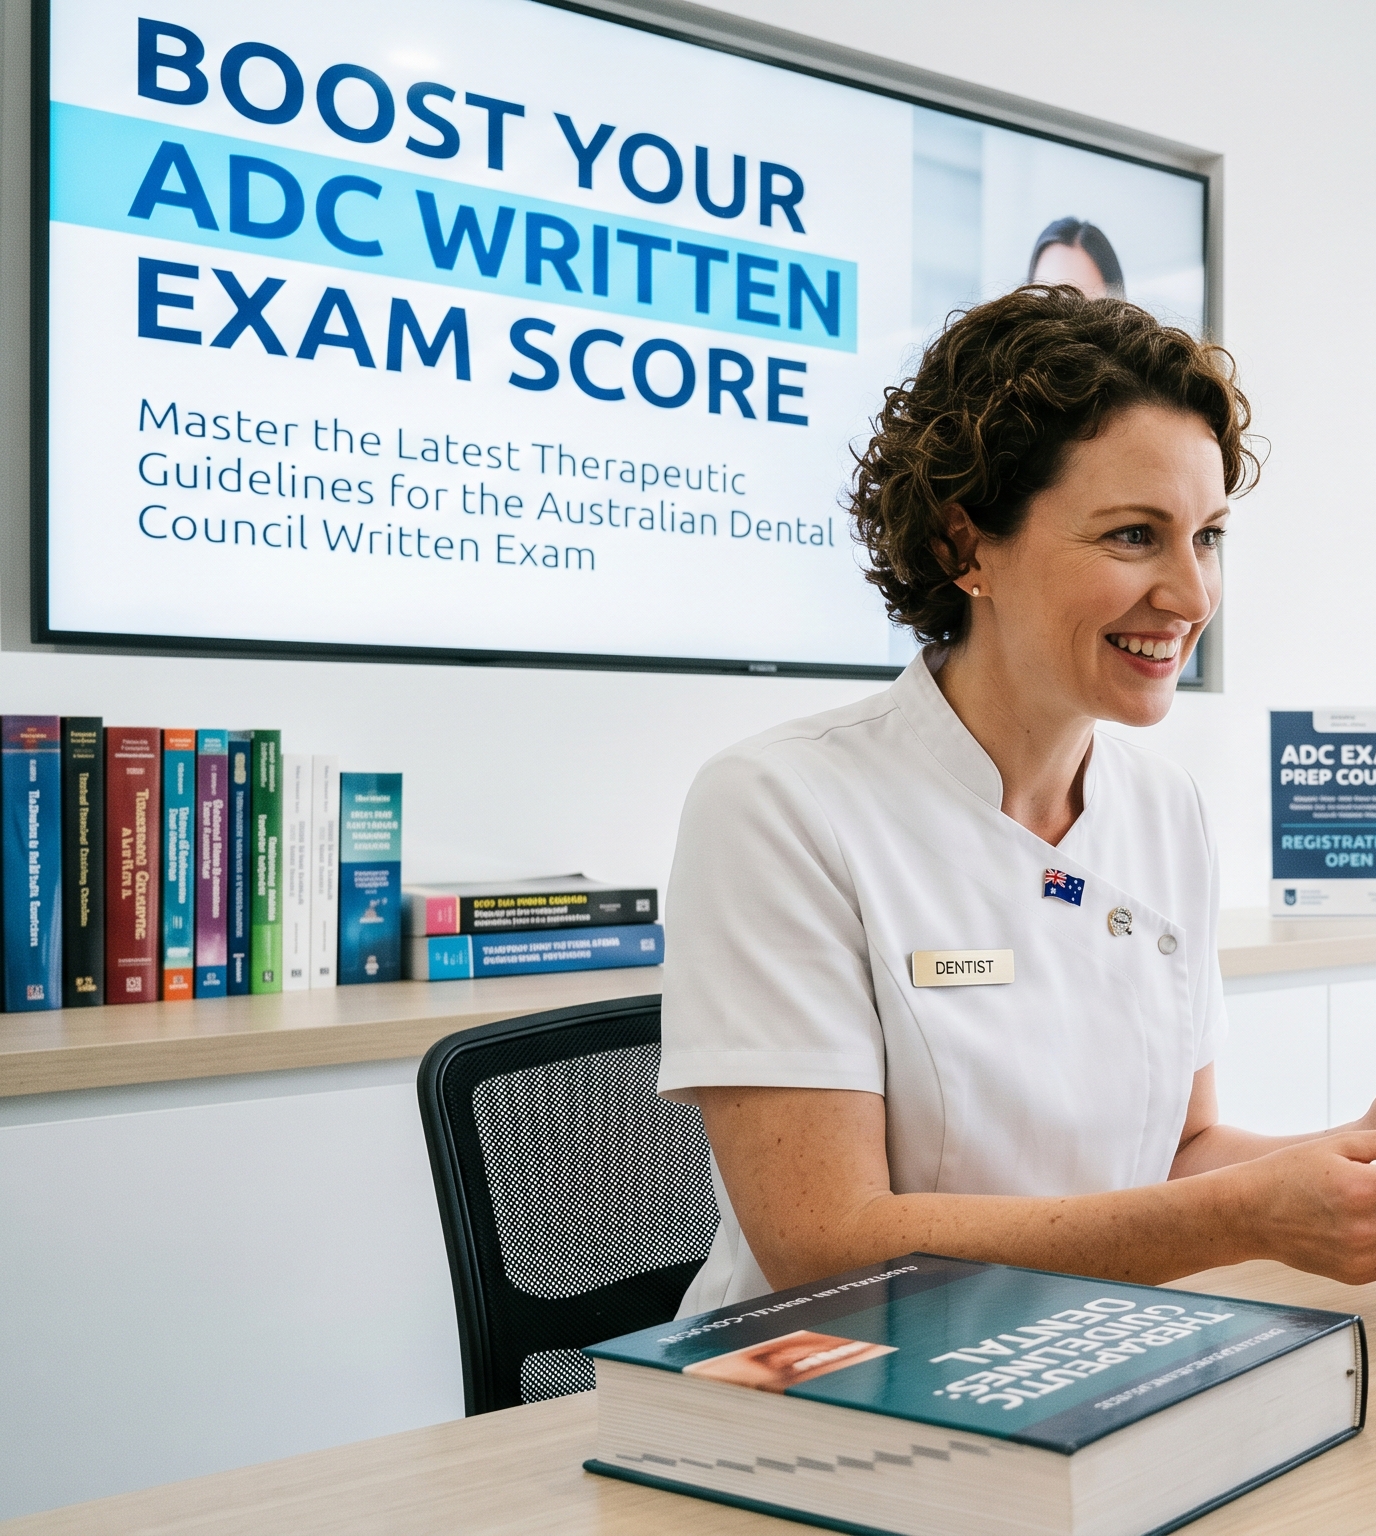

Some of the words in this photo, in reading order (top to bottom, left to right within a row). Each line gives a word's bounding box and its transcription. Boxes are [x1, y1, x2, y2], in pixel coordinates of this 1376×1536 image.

[137, 16, 526, 172] BOOST
[553, 112, 807, 235] YOUR
[127, 140, 384, 257] ADC
[415, 189, 841, 338] WRITTEN
[137, 256, 471, 382] EXAM
[508, 317, 809, 427] SCORE
[139, 398, 299, 447] Master
[314, 417, 382, 457] the
[398, 427, 521, 472] Latest
[531, 442, 746, 496] Therapeutic
[138, 452, 375, 505] Guidelines
[391, 473, 449, 511] for
[462, 481, 525, 519] the
[536, 491, 717, 536] Australian
[730, 510, 835, 547] Dental
[138, 504, 308, 550] Council
[322, 518, 480, 562] Written
[496, 533, 595, 571] Exam
[1280, 744, 1335, 766] ADC
[1280, 768, 1333, 786] PREP
[1325, 852, 1374, 868] OPEN
[935, 959, 994, 975] DENTIST
[928, 1297, 1137, 1365] DENTAL
[932, 1304, 1187, 1400] GUIDELINES:
[975, 1310, 1236, 1411] THERAPEUTIC
